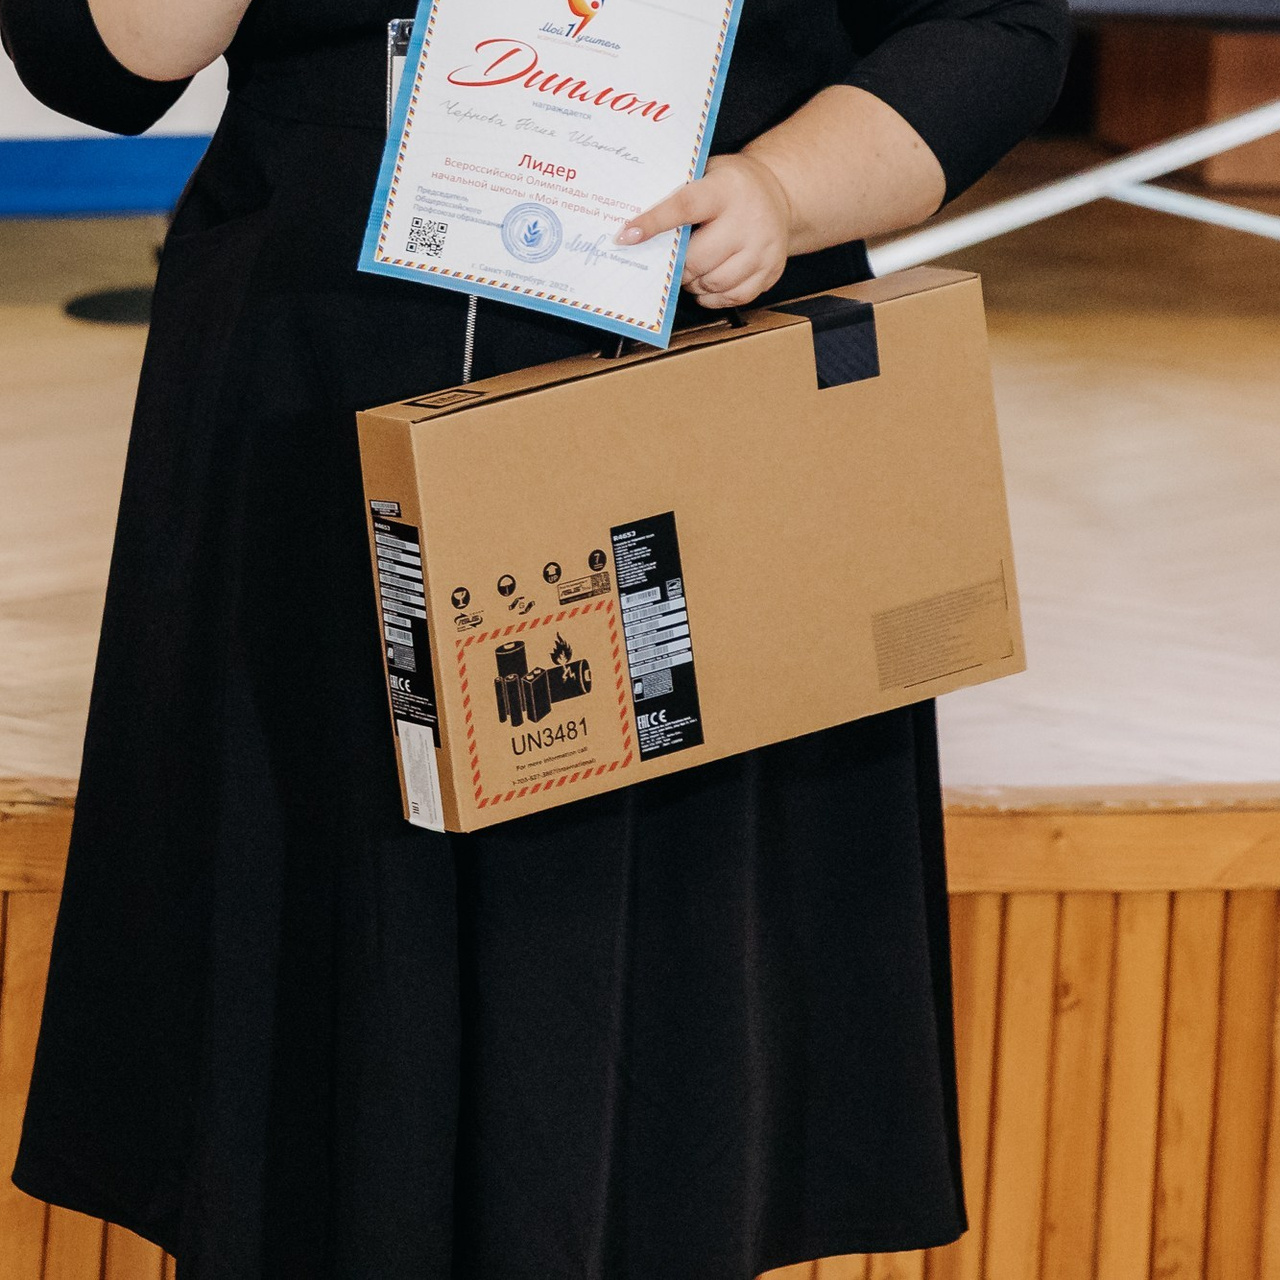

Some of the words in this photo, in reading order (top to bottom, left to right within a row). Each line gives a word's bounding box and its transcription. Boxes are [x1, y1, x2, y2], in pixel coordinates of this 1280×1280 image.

[539, 22, 564, 36] Мой
[576, 34, 621, 51] учитель
[447, 38, 676, 123] Диплом
[532, 101, 592, 121] награждается
[518, 154, 577, 181] Лидер
[431, 170, 489, 190] начальной
[490, 182, 526, 198] школы
[528, 191, 559, 207] «Мой
[561, 200, 601, 219] первый
[603, 210, 631, 226] учите
[444, 156, 524, 183] Всероссийской
[526, 174, 589, 200] Олимпиады
[592, 191, 642, 215] педагогов
[548, 574, 558, 583] UP
[511, 717, 588, 755] UN3481
[527, 760, 543, 768] more
[543, 750, 578, 764] information
